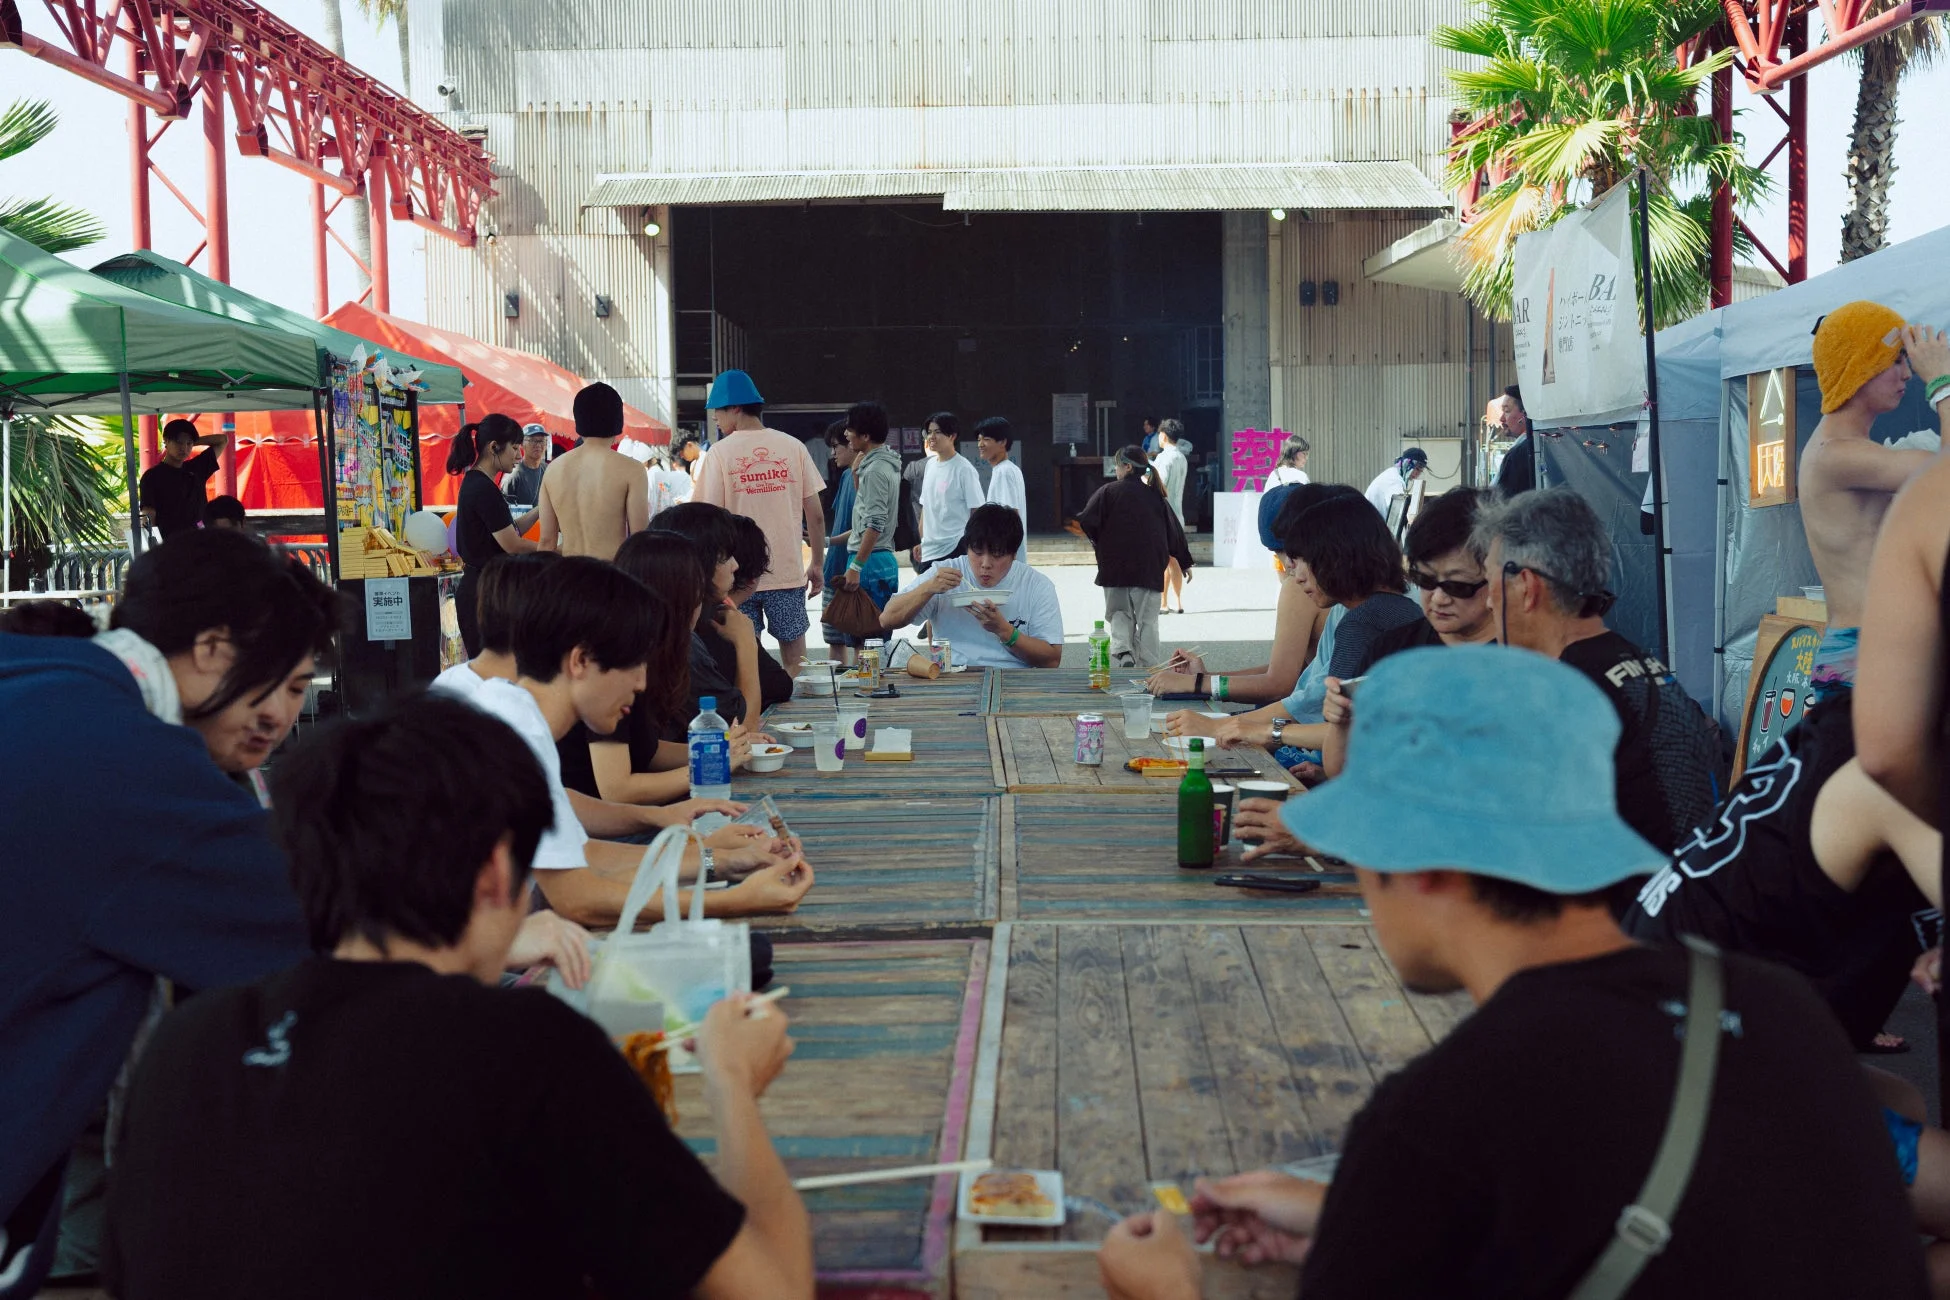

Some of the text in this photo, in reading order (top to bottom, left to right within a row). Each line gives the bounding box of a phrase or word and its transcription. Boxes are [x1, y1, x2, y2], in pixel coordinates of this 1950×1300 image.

[1589, 274, 1617, 301] BA
[740, 469, 788, 483] sumika
[372, 596, 403, 607] 実施中
